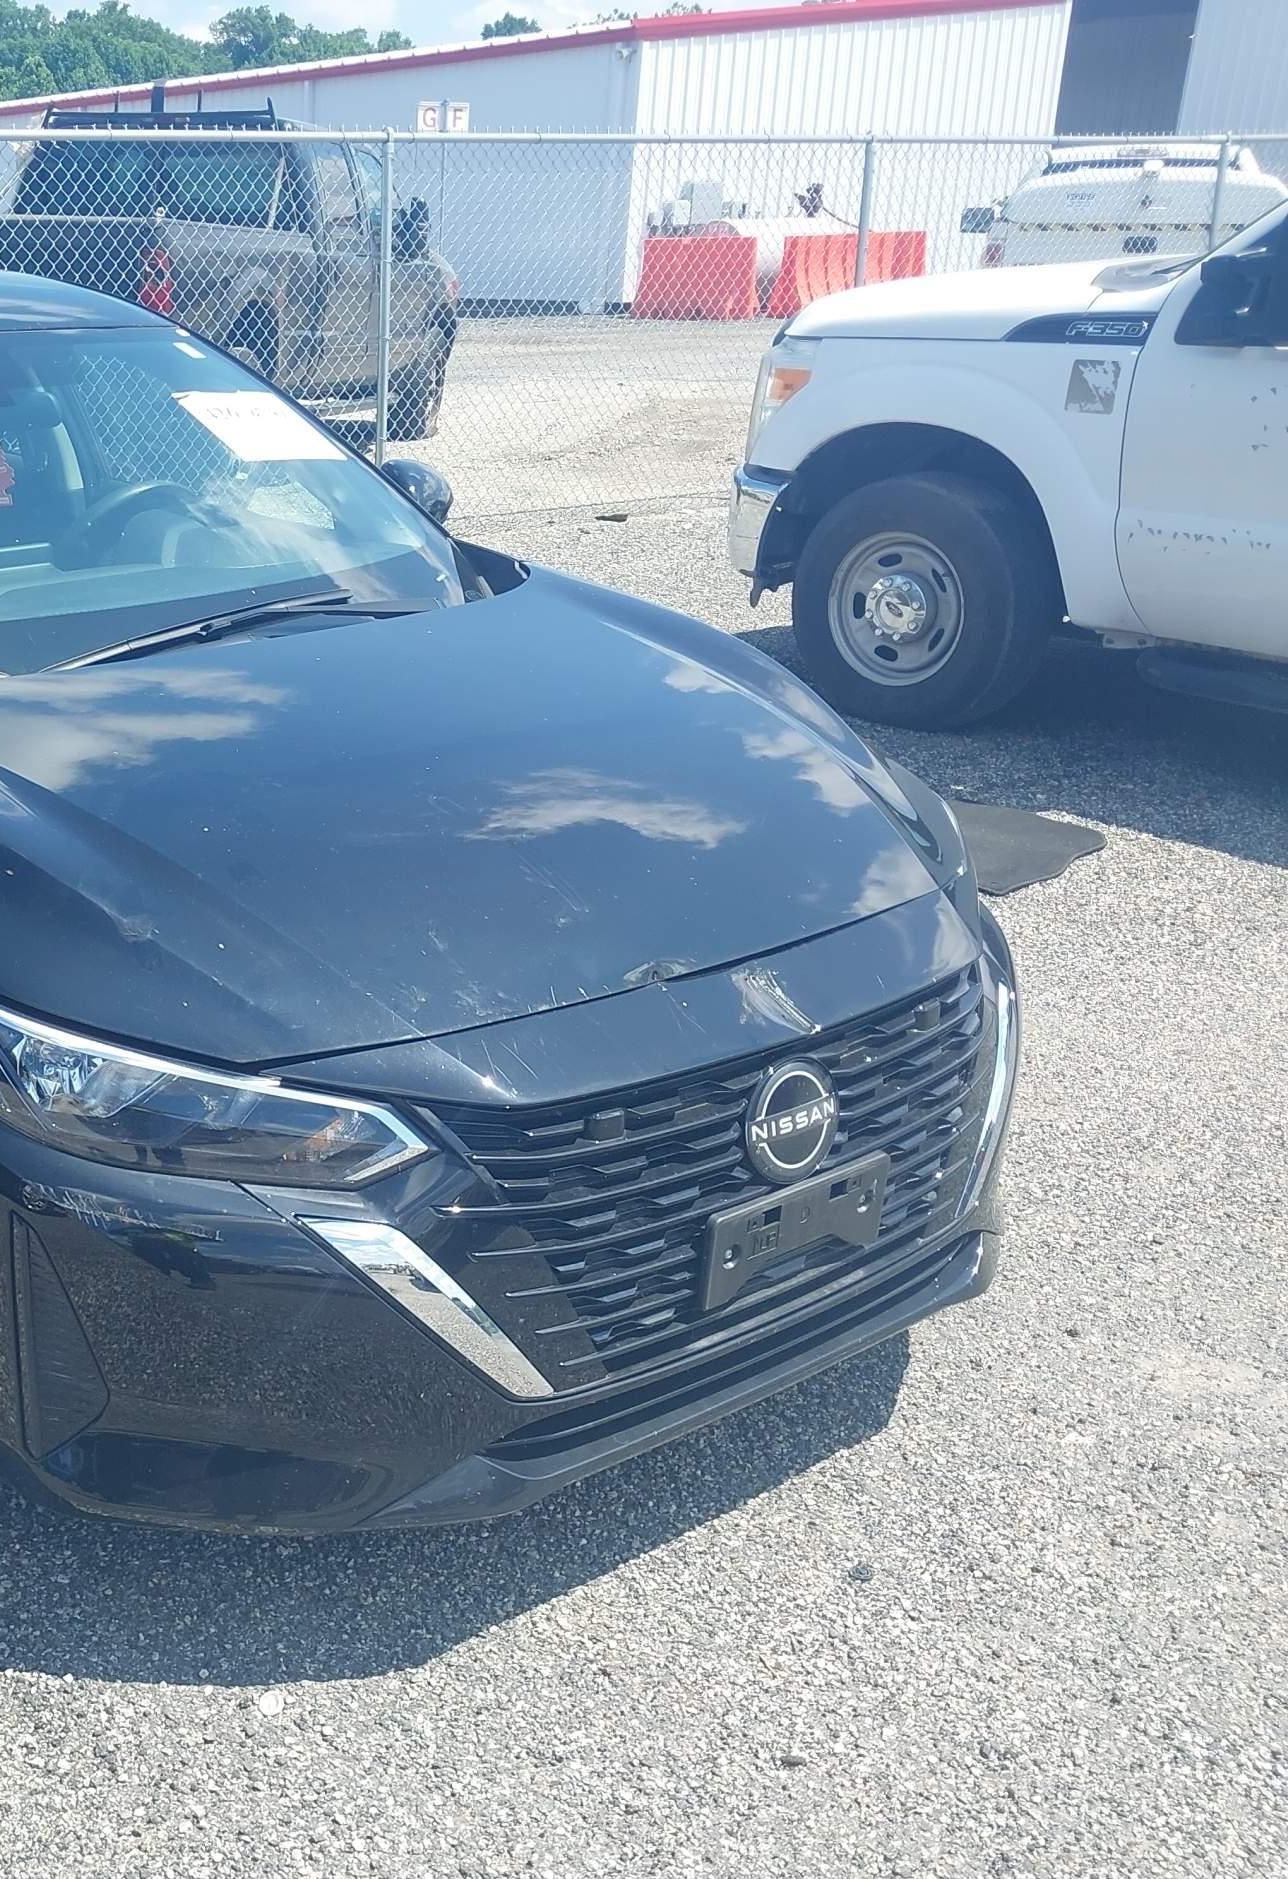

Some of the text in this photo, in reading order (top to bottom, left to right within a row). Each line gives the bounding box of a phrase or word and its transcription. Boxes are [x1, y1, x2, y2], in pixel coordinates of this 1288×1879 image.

[423, 107, 436, 128] G
[453, 108, 464, 128] F
[751, 1097, 835, 1142] NISSAN
